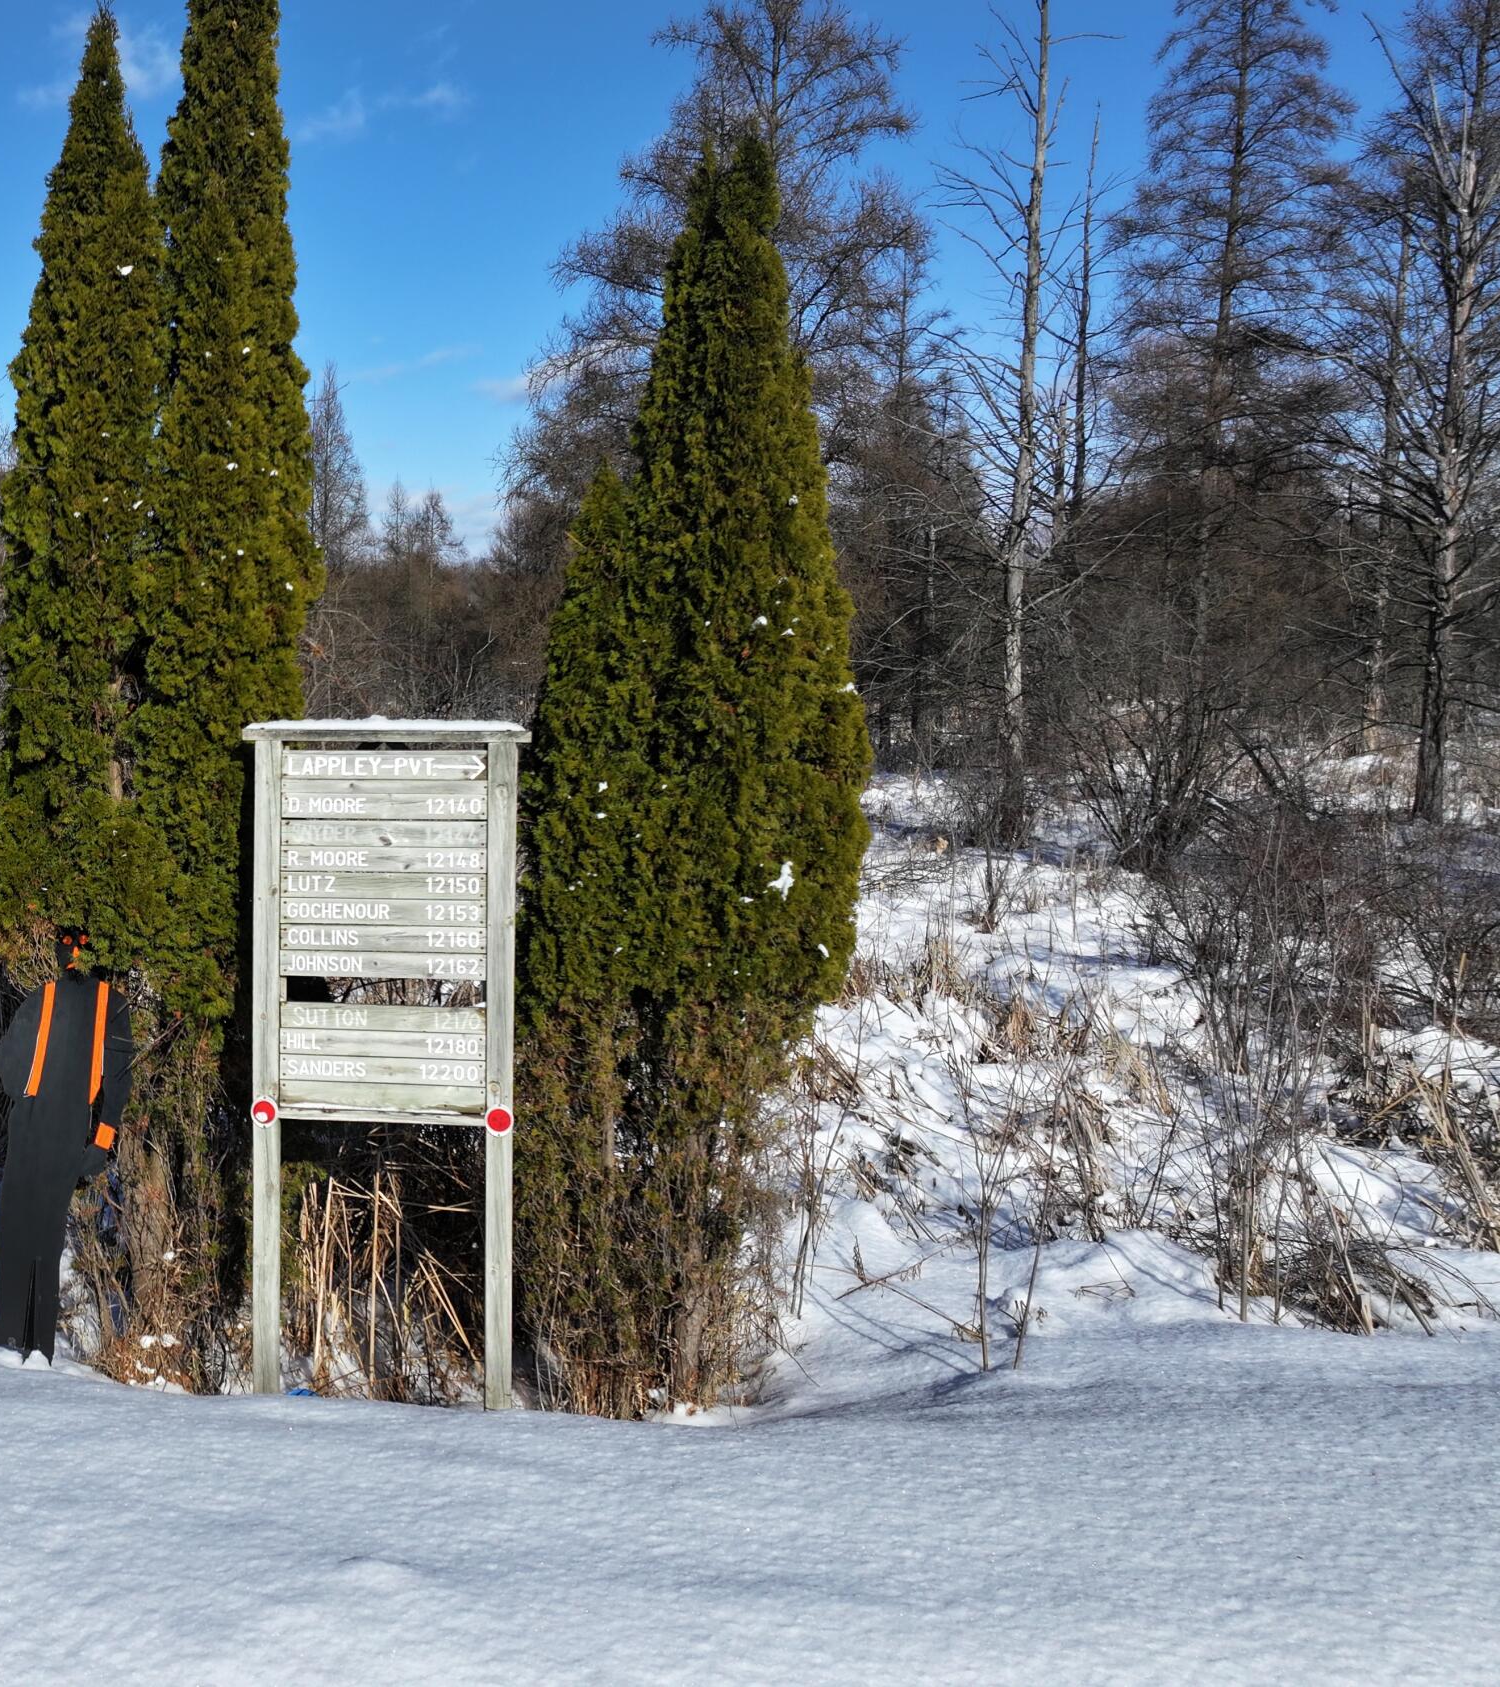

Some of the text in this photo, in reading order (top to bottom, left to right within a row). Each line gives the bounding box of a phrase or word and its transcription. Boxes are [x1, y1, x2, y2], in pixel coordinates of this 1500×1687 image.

[288, 797, 482, 815] D. MOORE 12140
[287, 850, 481, 869] R. MOORE 12148
[287, 876, 481, 895] LUTZ 12150
[286, 903, 480, 922] GOCHENOUR 12153
[287, 929, 481, 949] COLLINS 12160
[287, 955, 480, 975] JOHNSON 12162
[292, 1007, 481, 1030] SUTTON 12170
[286, 1032, 479, 1055] HILL 12180
[287, 1059, 479, 1082] SANDERS 12200
